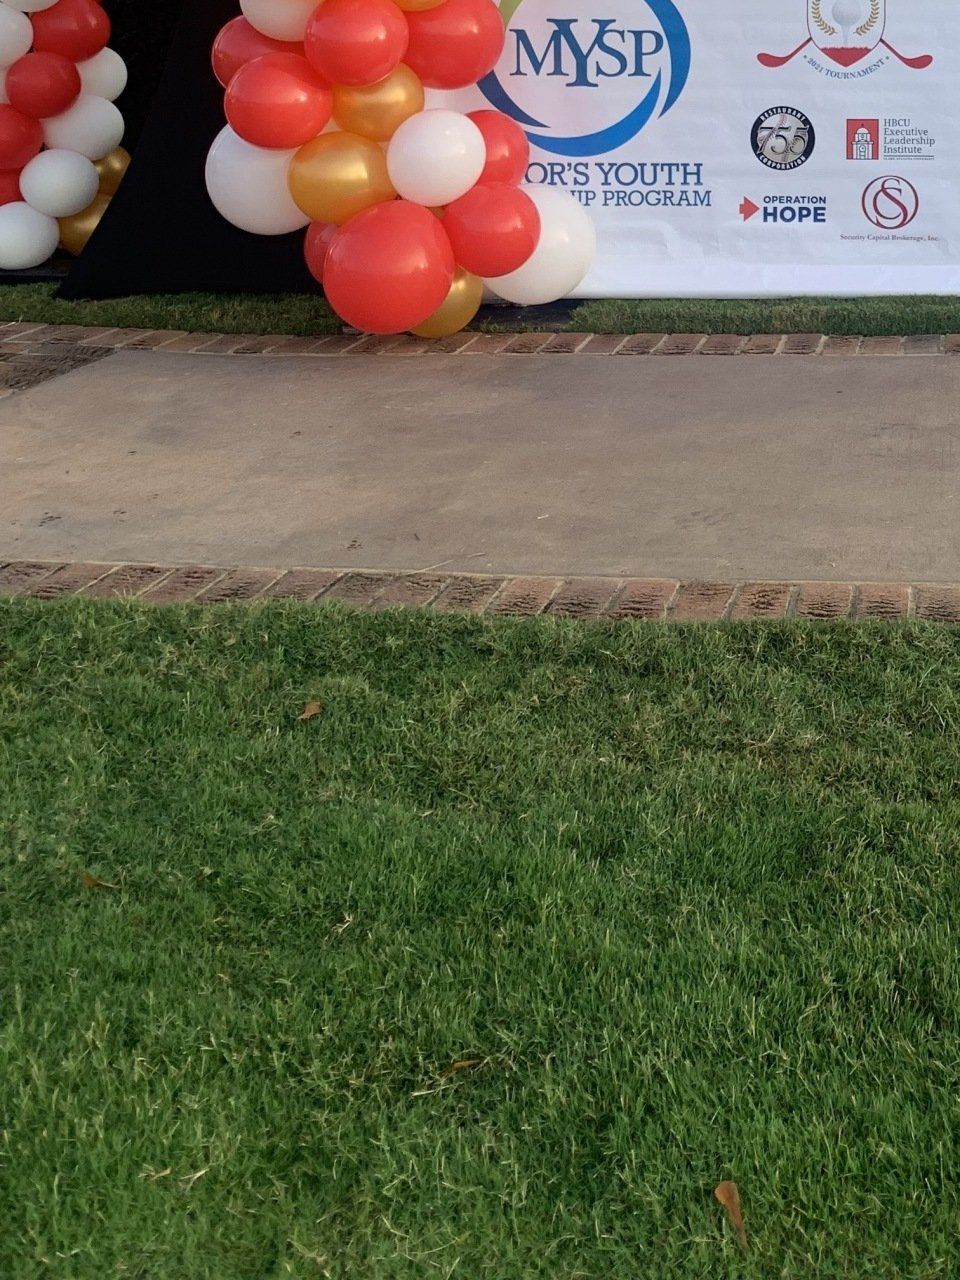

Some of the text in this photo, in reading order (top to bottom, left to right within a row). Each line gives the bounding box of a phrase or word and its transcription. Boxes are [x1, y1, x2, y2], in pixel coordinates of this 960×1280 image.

[510, 18, 664, 88] MYSP
[807, 58, 885, 80] 2021 TOURNAMENT
[883, 118, 911, 127] HBCU
[883, 128, 929, 136] Executive
[883, 137, 936, 147] Leadership
[883, 146, 923, 154] Institute
[759, 154, 806, 170] CORPORATION
[520, 162, 704, 186] OR'S YOUTH
[602, 190, 712, 207] PROGRAM
[763, 195, 826, 205] OPERATION
[762, 206, 826, 223] HOPE
[840, 233, 865, 241] Security
[867, 234, 890, 242] Capital
